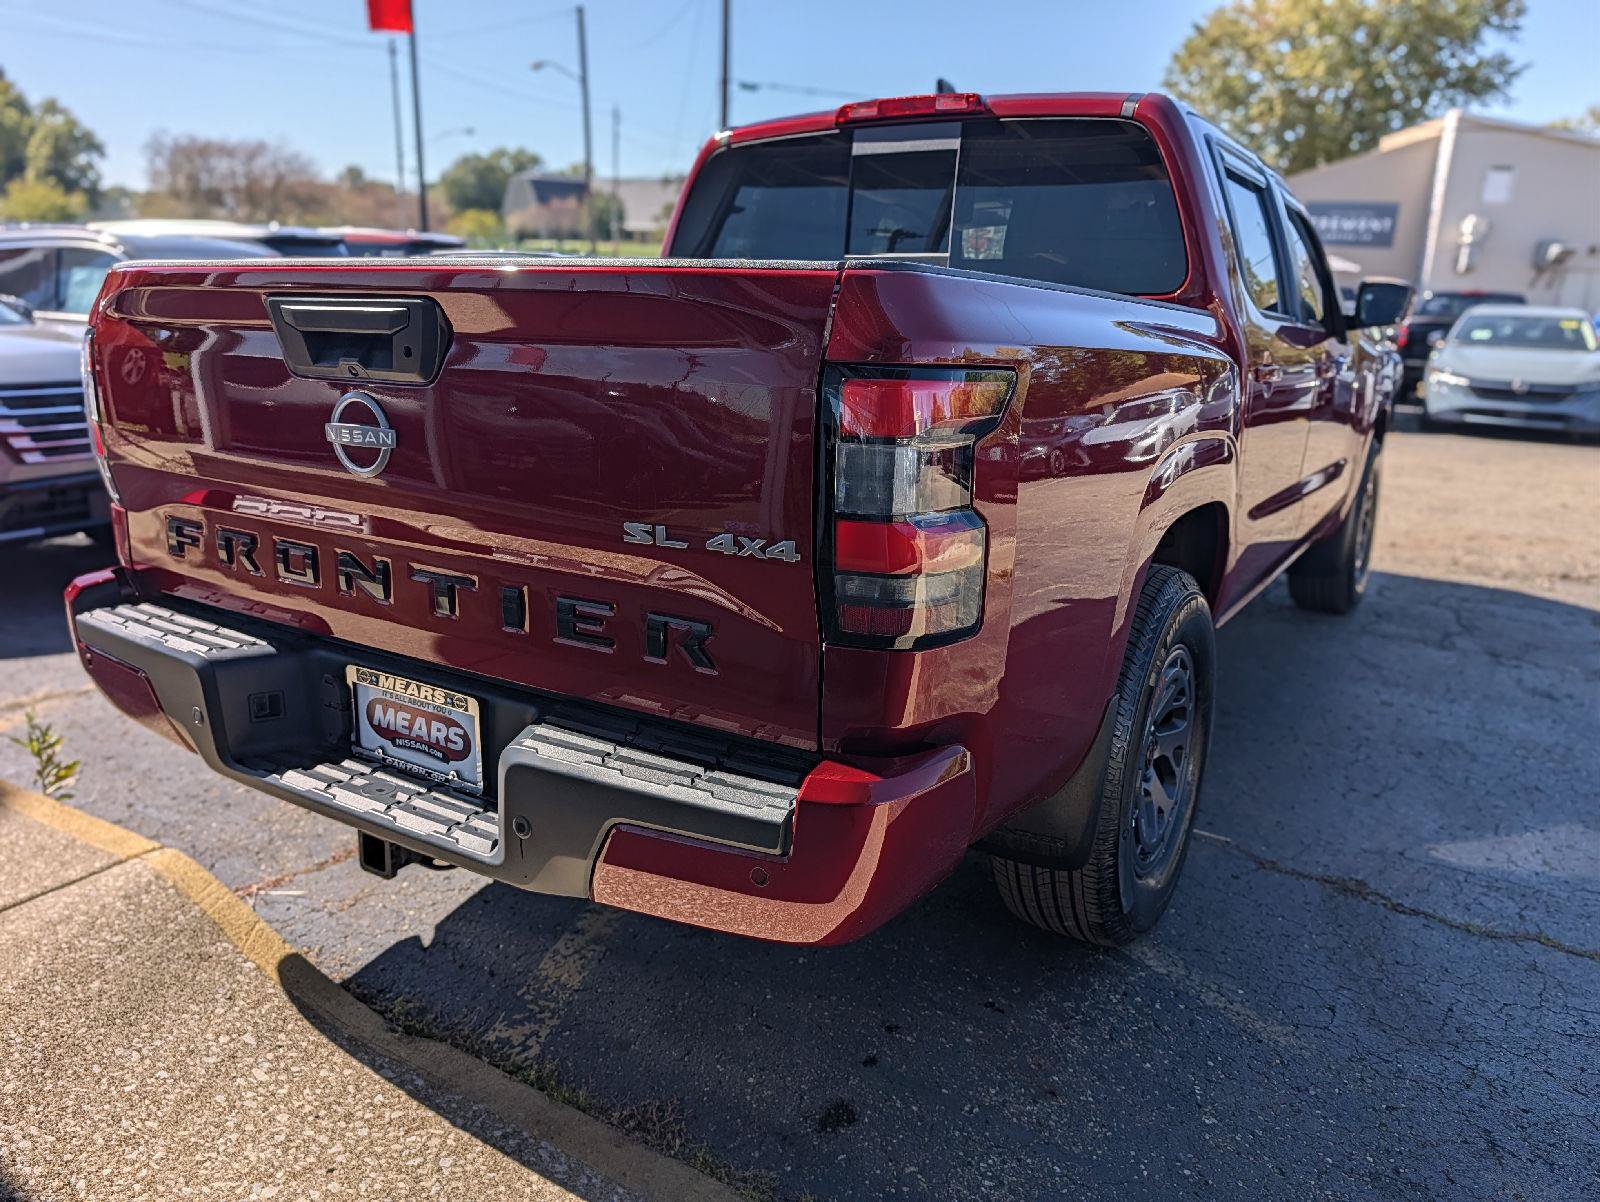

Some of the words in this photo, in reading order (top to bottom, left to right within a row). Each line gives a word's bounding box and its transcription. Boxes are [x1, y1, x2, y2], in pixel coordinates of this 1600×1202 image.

[327, 426, 392, 445] NISSAN
[623, 521, 690, 548] SL
[165, 513, 721, 676] FRONTIER
[379, 674, 446, 705] MEARS
[407, 698, 431, 709] ABOUT
[432, 704, 447, 714] YOU
[373, 704, 465, 751] MEARS
